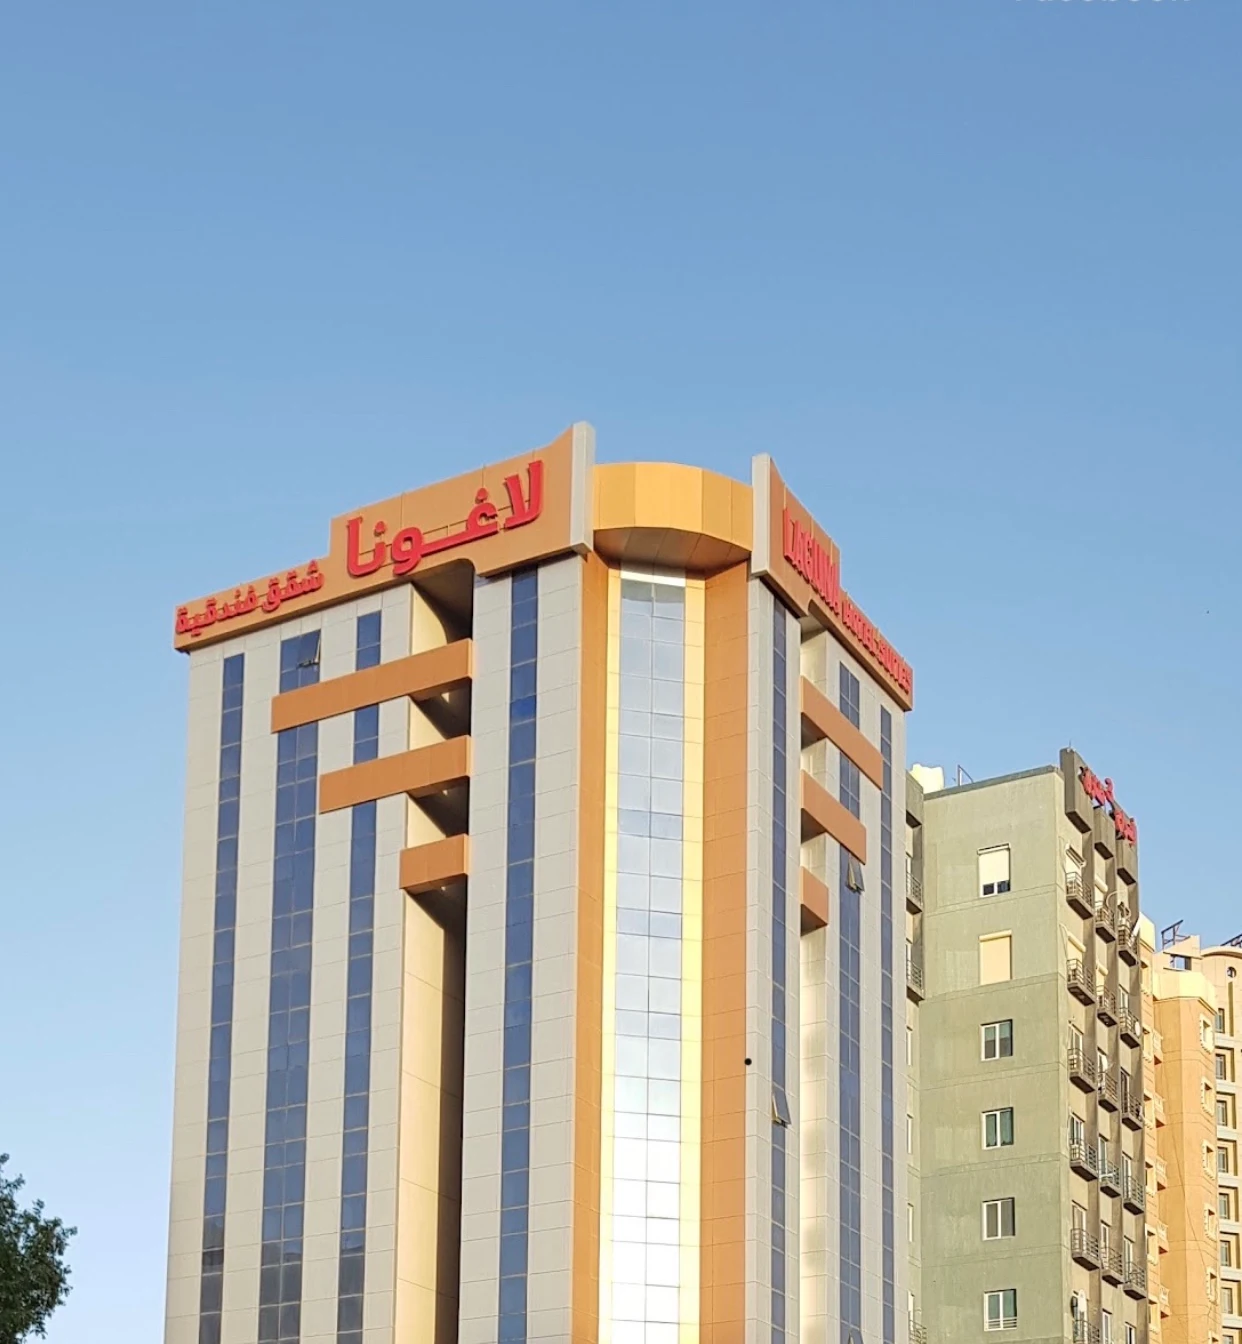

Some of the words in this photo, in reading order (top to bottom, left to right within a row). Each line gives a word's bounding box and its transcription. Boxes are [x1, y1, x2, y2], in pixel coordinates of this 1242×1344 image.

[346, 459, 543, 576] لاغونا
[262, 559, 325, 613] شقق
[783, 507, 840, 616] LAGUNA
[175, 584, 258, 638] فندقية
